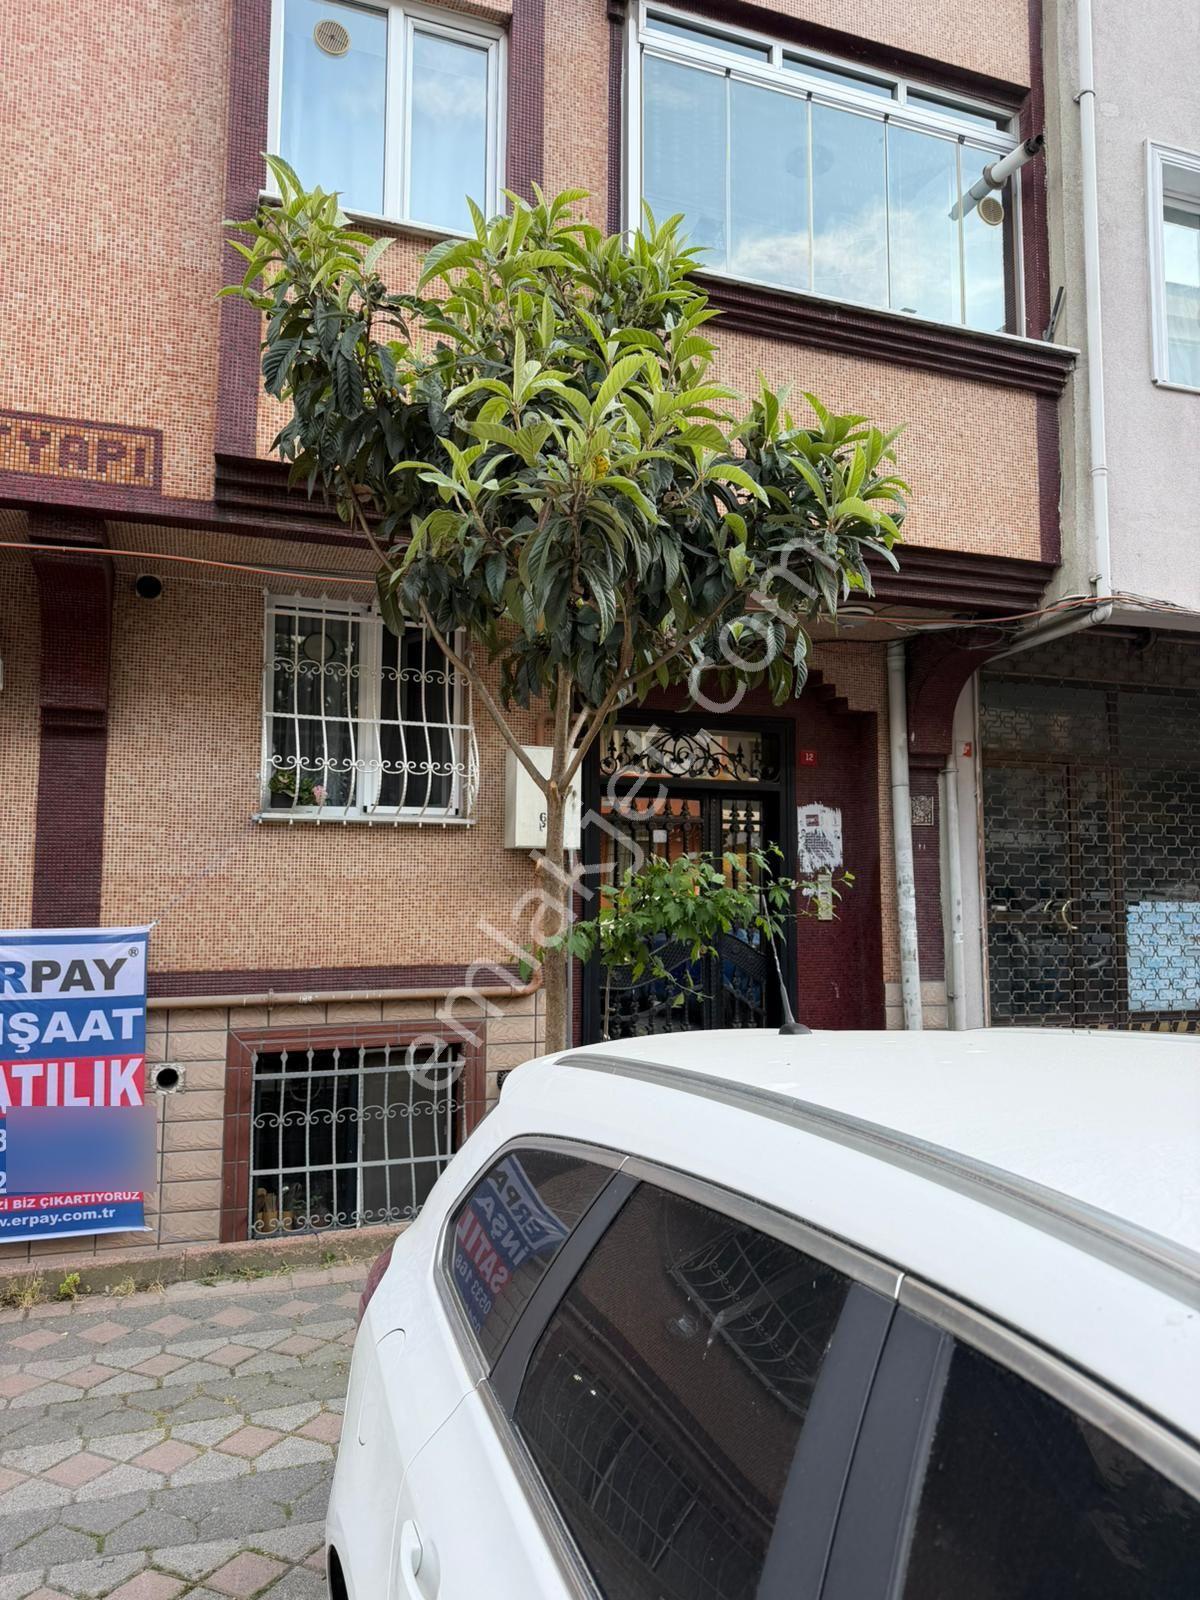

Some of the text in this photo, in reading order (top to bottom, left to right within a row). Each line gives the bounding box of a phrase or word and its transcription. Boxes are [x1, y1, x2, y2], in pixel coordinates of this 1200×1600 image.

[805, 752, 814, 761] 12
[0, 1007, 143, 1053] ŞAAT
[13, 1197, 36, 1209] BİZ
[40, 1191, 140, 1209] ÇIKARTIYORUZ
